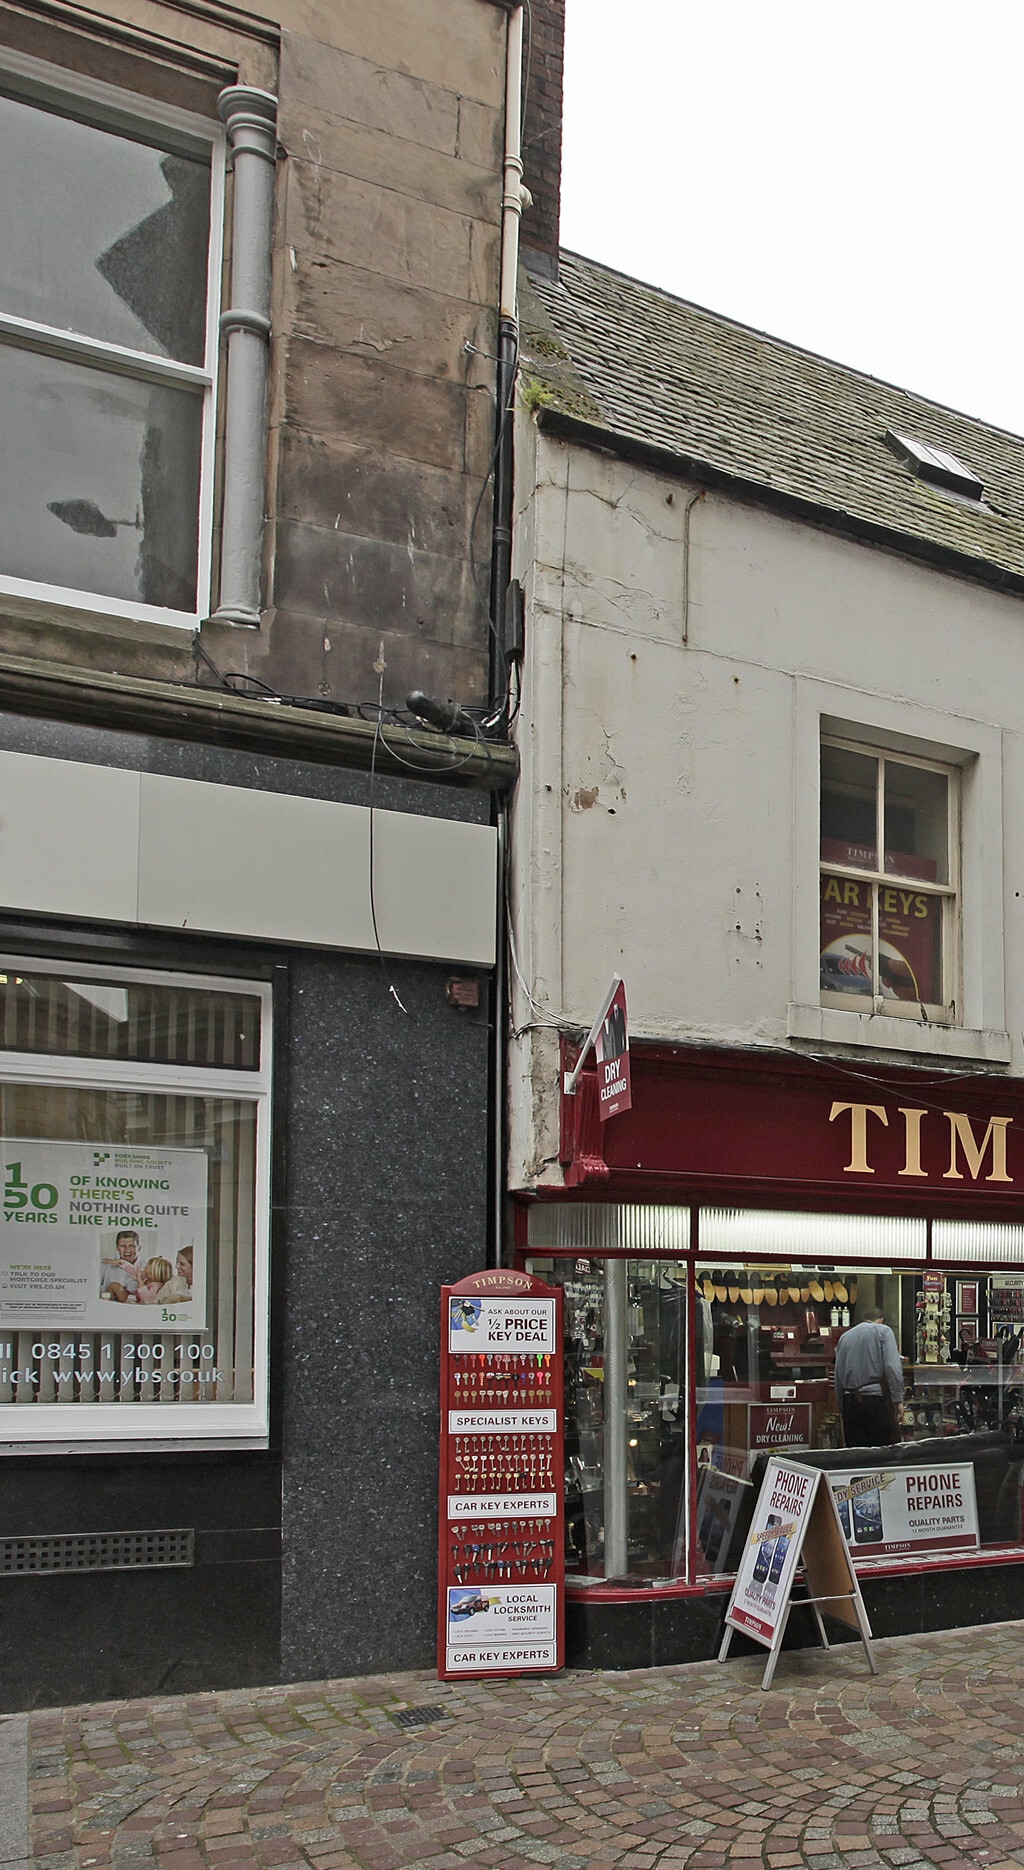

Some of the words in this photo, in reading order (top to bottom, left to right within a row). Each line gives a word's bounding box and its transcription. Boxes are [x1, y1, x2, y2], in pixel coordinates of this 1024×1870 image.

[846, 848, 896, 864] TIMPN
[822, 877, 859, 906] AR
[605, 1059, 620, 1084] DRY
[601, 1078, 626, 1101] CLEANING
[70, 1176, 91, 1186] OF
[96, 1176, 170, 1190] KNOWING
[70, 1188, 134, 1201] THERE'S
[70, 1202, 140, 1214] NOTHING
[144, 1204, 190, 1216] QUITE
[3, 1211, 58, 1224] YEARS
[69, 1214, 103, 1226] LIKE
[108, 1216, 158, 1228] HOME.
[473, 1276, 533, 1290] TIMPSON
[505, 1319, 547, 1330] PRICE
[488, 1332, 512, 1341] KEY
[516, 1332, 548, 1341] DEAL
[32, 1344, 91, 1359] 0845
[101, 1344, 111, 1359] 1
[123, 1344, 165, 1360] 200
[174, 1344, 215, 1360] 100
[52, 1367, 225, 1386] www.ybs.co.uk
[457, 1417, 517, 1426] SPECIALIST
[522, 1416, 549, 1425] KEYS
[766, 1415, 794, 1432] New!
[756, 1435, 769, 1443] DRY
[771, 1434, 804, 1442] CLEANING
[774, 1470, 809, 1498] PHONE
[850, 1473, 885, 1496] SERVICE
[906, 1473, 960, 1493] PHONE
[455, 1502, 477, 1511] CAR
[481, 1501, 501, 1510] KEY
[504, 1500, 550, 1510] EXPERTS
[770, 1491, 803, 1516] REPAIRS
[907, 1494, 963, 1511] REPAIRS
[909, 1518, 940, 1527] QUALITY
[942, 1516, 965, 1524] PARTS
[506, 1595, 538, 1603] LOCAL
[745, 1587, 762, 1604] QUALITY
[761, 1596, 776, 1610] PARTS
[494, 1605, 551, 1615] LOCKSMITH
[454, 1653, 476, 1662] CAR
[480, 1652, 500, 1661] KEY
[503, 1650, 549, 1660] EXPERTS
